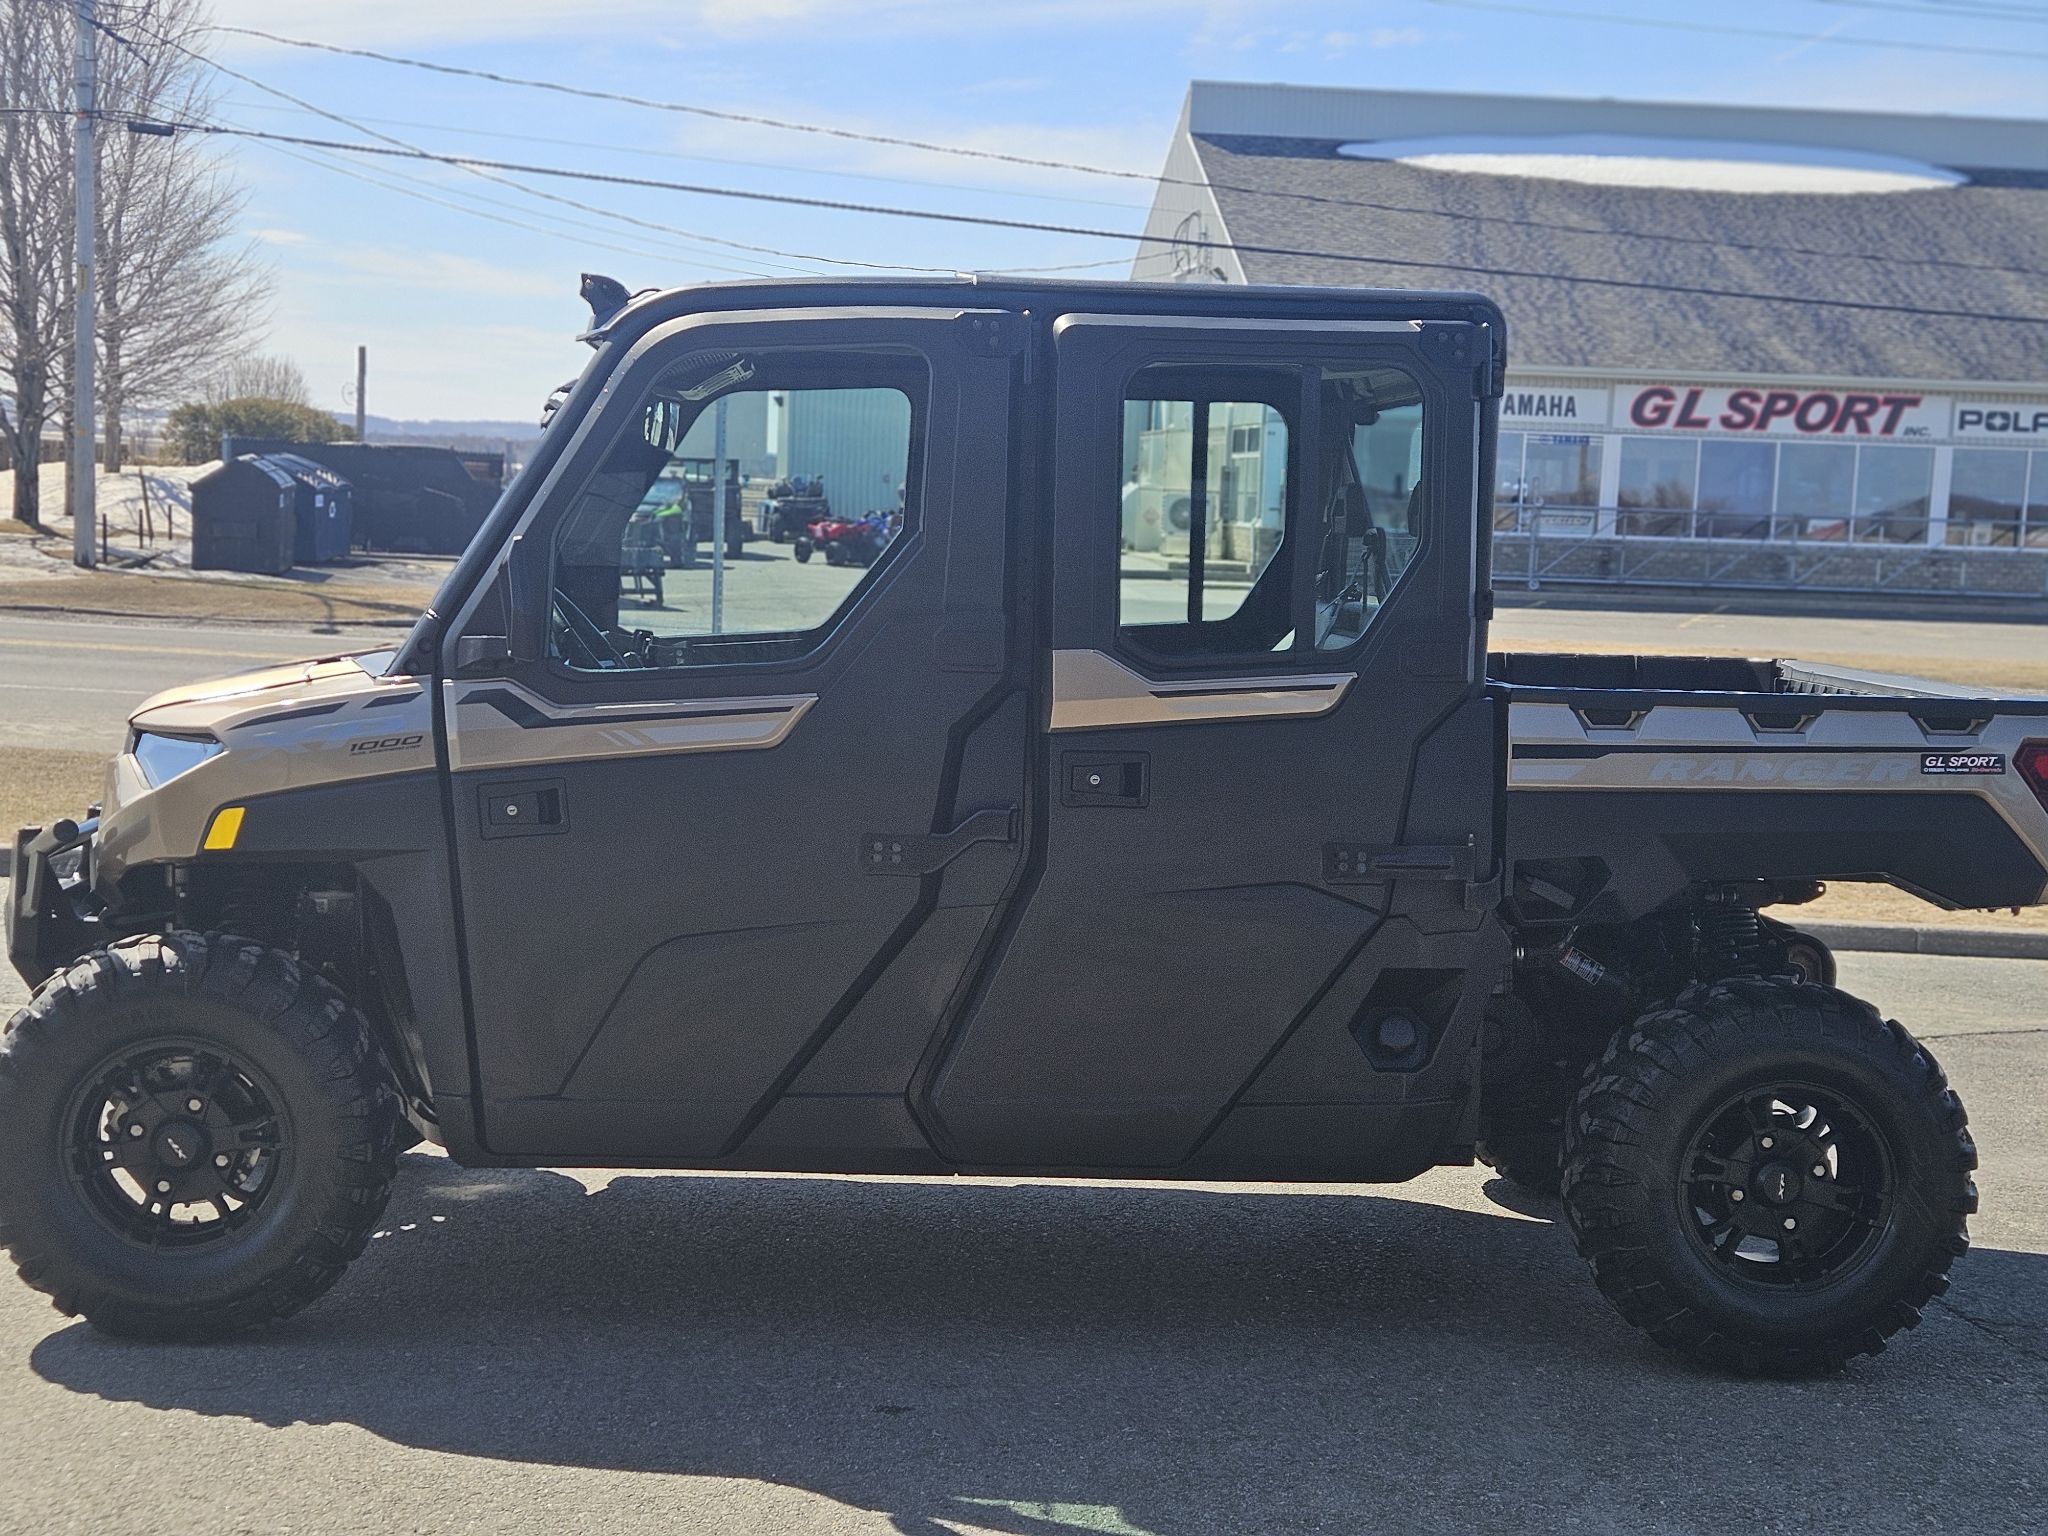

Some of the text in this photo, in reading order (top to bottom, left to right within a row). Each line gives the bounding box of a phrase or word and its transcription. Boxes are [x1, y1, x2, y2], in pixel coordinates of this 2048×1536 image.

[1502, 393, 1577, 418] AMAHA
[1630, 386, 1932, 438] GL SPORT INC.
[350, 735, 423, 752] 1000
[1651, 757, 1918, 782] RANGER
[1925, 756, 1998, 767] GL SPORT
